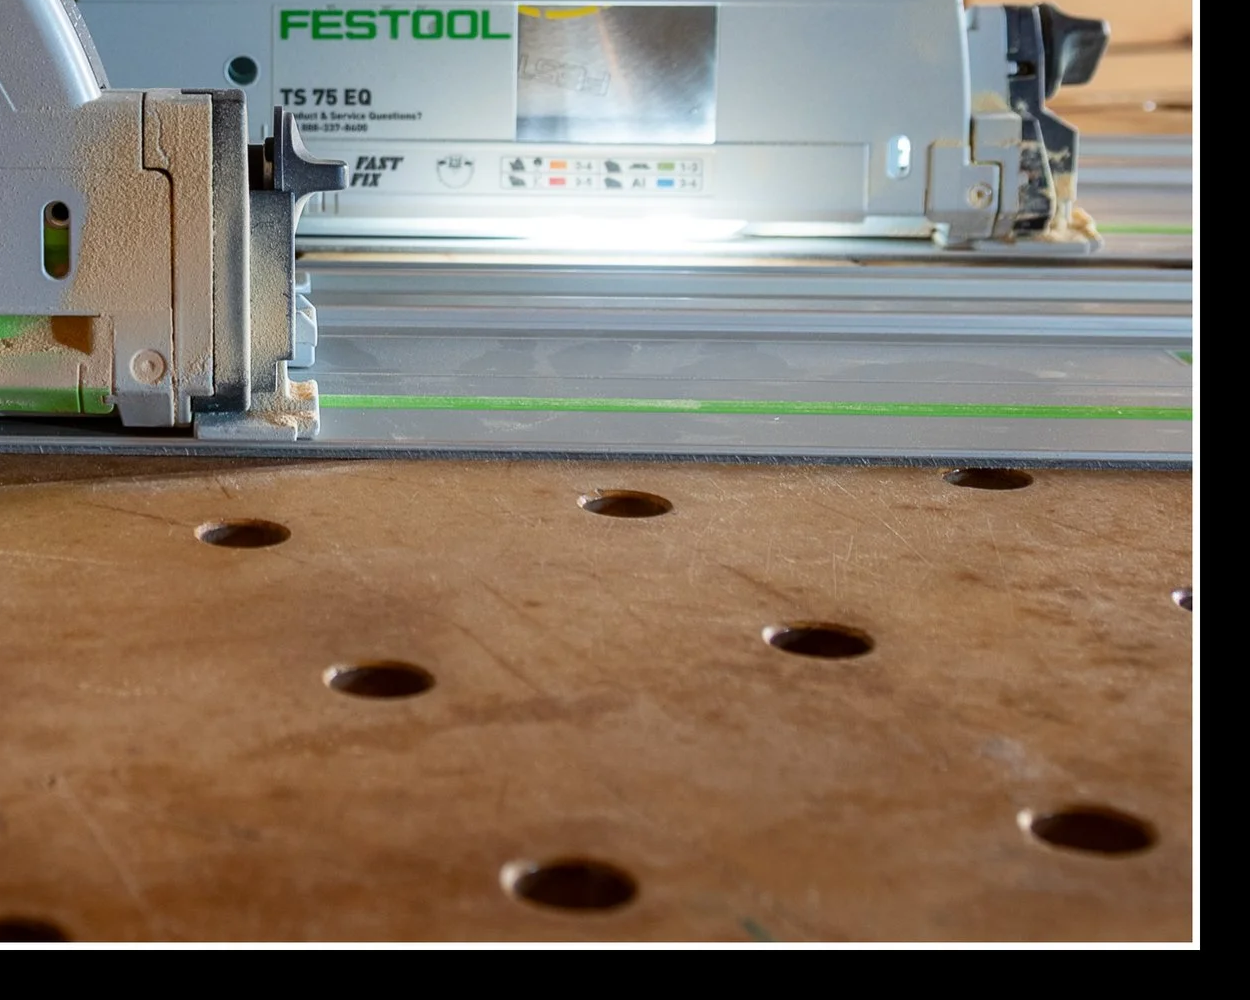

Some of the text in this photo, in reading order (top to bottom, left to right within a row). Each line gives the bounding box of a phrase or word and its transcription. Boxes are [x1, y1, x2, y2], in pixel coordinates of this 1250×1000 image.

[280, 10, 511, 40] FESTOOL
[280, 89, 372, 105] TS 75 EQ
[330, 112, 366, 120] Service
[368, 112, 422, 121] Questions?
[355, 156, 404, 171] FAST
[350, 173, 382, 187] FIX
